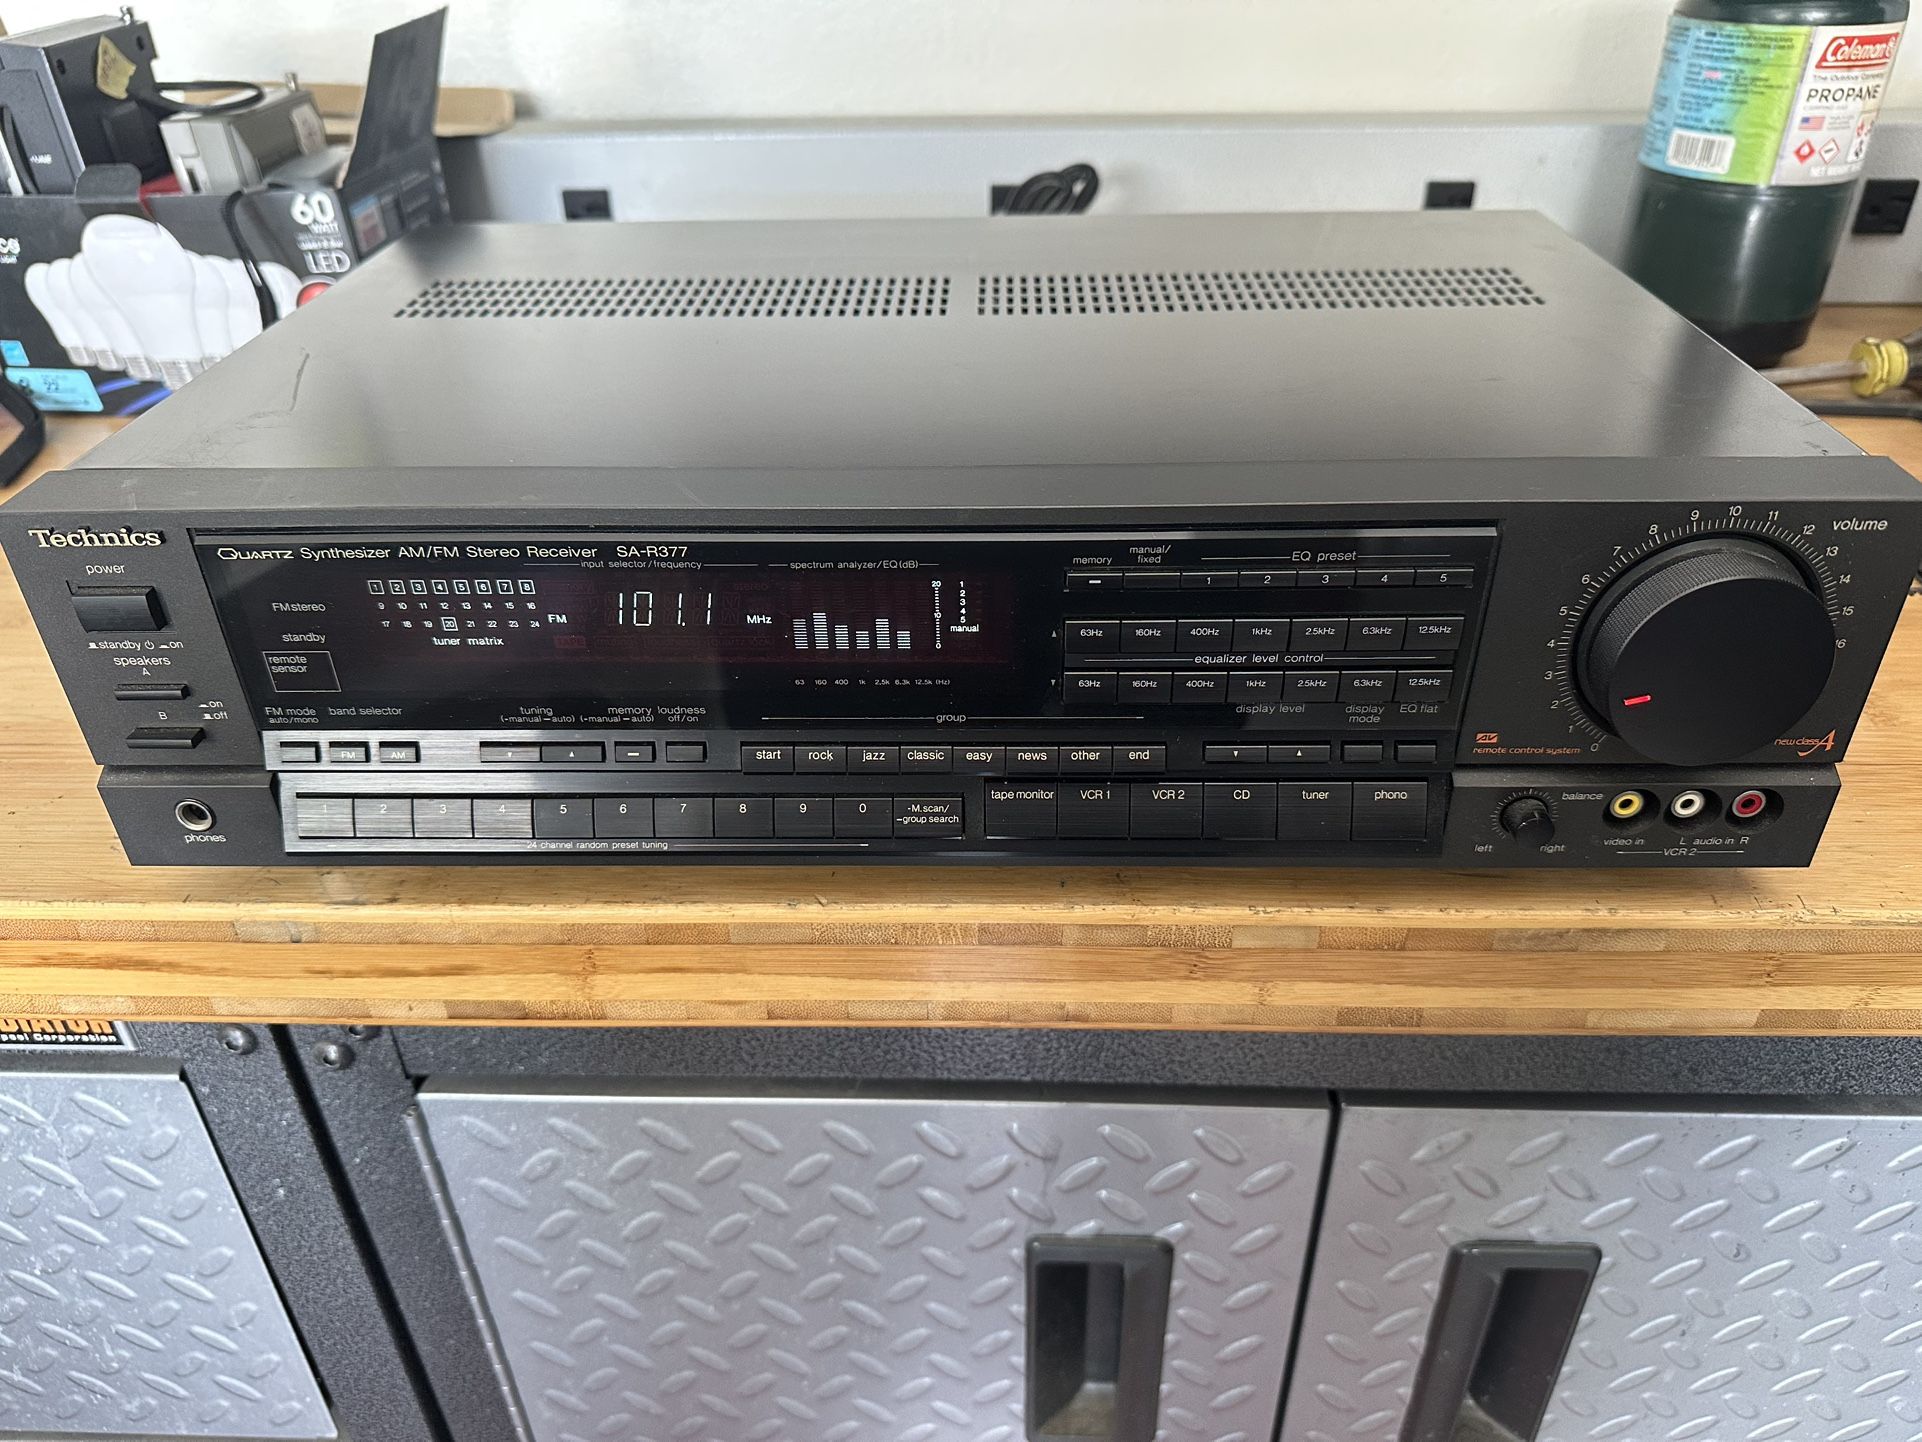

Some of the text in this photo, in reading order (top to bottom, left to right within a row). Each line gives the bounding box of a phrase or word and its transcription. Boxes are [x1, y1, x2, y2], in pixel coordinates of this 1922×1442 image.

[1806, 84, 1882, 103] PROPANE
[291, 191, 335, 225] 60
[303, 249, 351, 273] LED
[1690, 510, 1700, 521] 9
[1729, 505, 1742, 517] 10
[1768, 510, 1779, 521] 11
[1832, 518, 1888, 531] volume
[1648, 524, 1659, 536] 8
[1802, 524, 1816, 536] 12
[28, 528, 163, 548] Technics
[300, 547, 391, 562] Synthesizer
[398, 546, 460, 559] AM/FM
[466, 546, 520, 559] Stereo
[526, 546, 598, 559] Receiver
[616, 546, 688, 559] SA-R377
[1129, 545, 1172, 555] manual/
[1613, 546, 1622, 557] 7
[1825, 546, 1839, 557] 13
[1072, 556, 1113, 566] memory
[1137, 555, 1162, 564] fixed
[1291, 551, 1357, 563] EQ preset
[85, 563, 125, 576] power
[580, 560, 702, 570] input selector/frequency
[790, 560, 834, 571] spectrum
[1264, 576, 1271, 584] 2
[1322, 575, 1329, 584] 3
[1381, 574, 1388, 583] 4
[1440, 574, 1447, 583] 5
[1581, 574, 1591, 585] 6
[1838, 574, 1851, 585] 14
[272, 602, 326, 612] FM stereo
[378, 602, 536, 610] 9 10 11 12 13 14 15 16
[1558, 606, 1568, 616] 5
[1841, 606, 1854, 616] 15
[548, 614, 568, 624] FM
[746, 615, 772, 624] MHz
[950, 624, 979, 633] manual
[1080, 629, 1103, 637] 63Hz
[1135, 629, 1161, 637] 160Hz
[1190, 628, 1220, 637] 400Hz
[1251, 627, 1273, 636] 1kHz
[282, 632, 326, 644] standby
[432, 636, 504, 646] tuner matrix
[99, 639, 184, 651] standby on
[1546, 639, 1555, 648] 4
[113, 655, 171, 667] speakers
[268, 655, 307, 664] remote
[1194, 653, 1324, 665] equalizer level control
[142, 667, 151, 676] A
[271, 664, 308, 673] sensor
[1544, 671, 1553, 680] 3
[1078, 680, 1101, 688] 63Hz
[1132, 680, 1157, 688] 160Hz
[1186, 680, 1215, 688] 400Hz
[1246, 680, 1266, 688] 1kHz
[208, 700, 224, 709] on
[1235, 703, 1305, 714] display level
[1345, 704, 1385, 715] display
[1399, 704, 1438, 714] EQ flat
[265, 707, 317, 716] FM mode
[329, 706, 402, 716] band selector
[519, 706, 553, 716] tuning
[608, 706, 651, 716] memory
[657, 705, 706, 715] loudness
[268, 716, 320, 725] auto/mono
[668, 714, 699, 723] off/on
[936, 713, 967, 724] group
[1349, 714, 1381, 723] mode
[341, 751, 355, 760] FM
[391, 751, 406, 760] AM
[755, 750, 782, 760] start
[808, 750, 833, 760] rock
[907, 750, 945, 760] classic
[1070, 750, 1100, 761] other
[1128, 750, 1150, 760] end
[1509, 746, 1544, 754] control
[1545, 747, 1581, 755] system
[862, 750, 886, 762] jazz
[966, 751, 993, 762] easy
[1017, 751, 1047, 761] news
[991, 789, 1055, 801] tape monitor
[1080, 789, 1104, 800] VCR
[1152, 789, 1185, 800] VCR 2
[1233, 789, 1250, 800] CD
[1301, 789, 1330, 800] tuner
[1374, 789, 1408, 801] phono
[1562, 791, 1604, 801] balance
[380, 804, 388, 814] 2
[439, 804, 447, 814] 3
[498, 804, 506, 814] 4
[559, 804, 568, 814] 5
[619, 804, 628, 814] 6
[680, 803, 688, 814] 7
[738, 803, 748, 814] 8
[799, 803, 808, 814] 9
[858, 803, 867, 814] 0
[928, 814, 960, 824] search
[185, 832, 226, 844] phones
[1603, 837, 1632, 846] video
[1693, 836, 1722, 845] audio
[526, 840, 669, 851] 24 channel random preset tuning
[1474, 844, 1494, 853] left
[1540, 844, 1566, 854] right
[1662, 848, 1688, 856] VCR
[32, 1033, 117, 1043] Corporation
